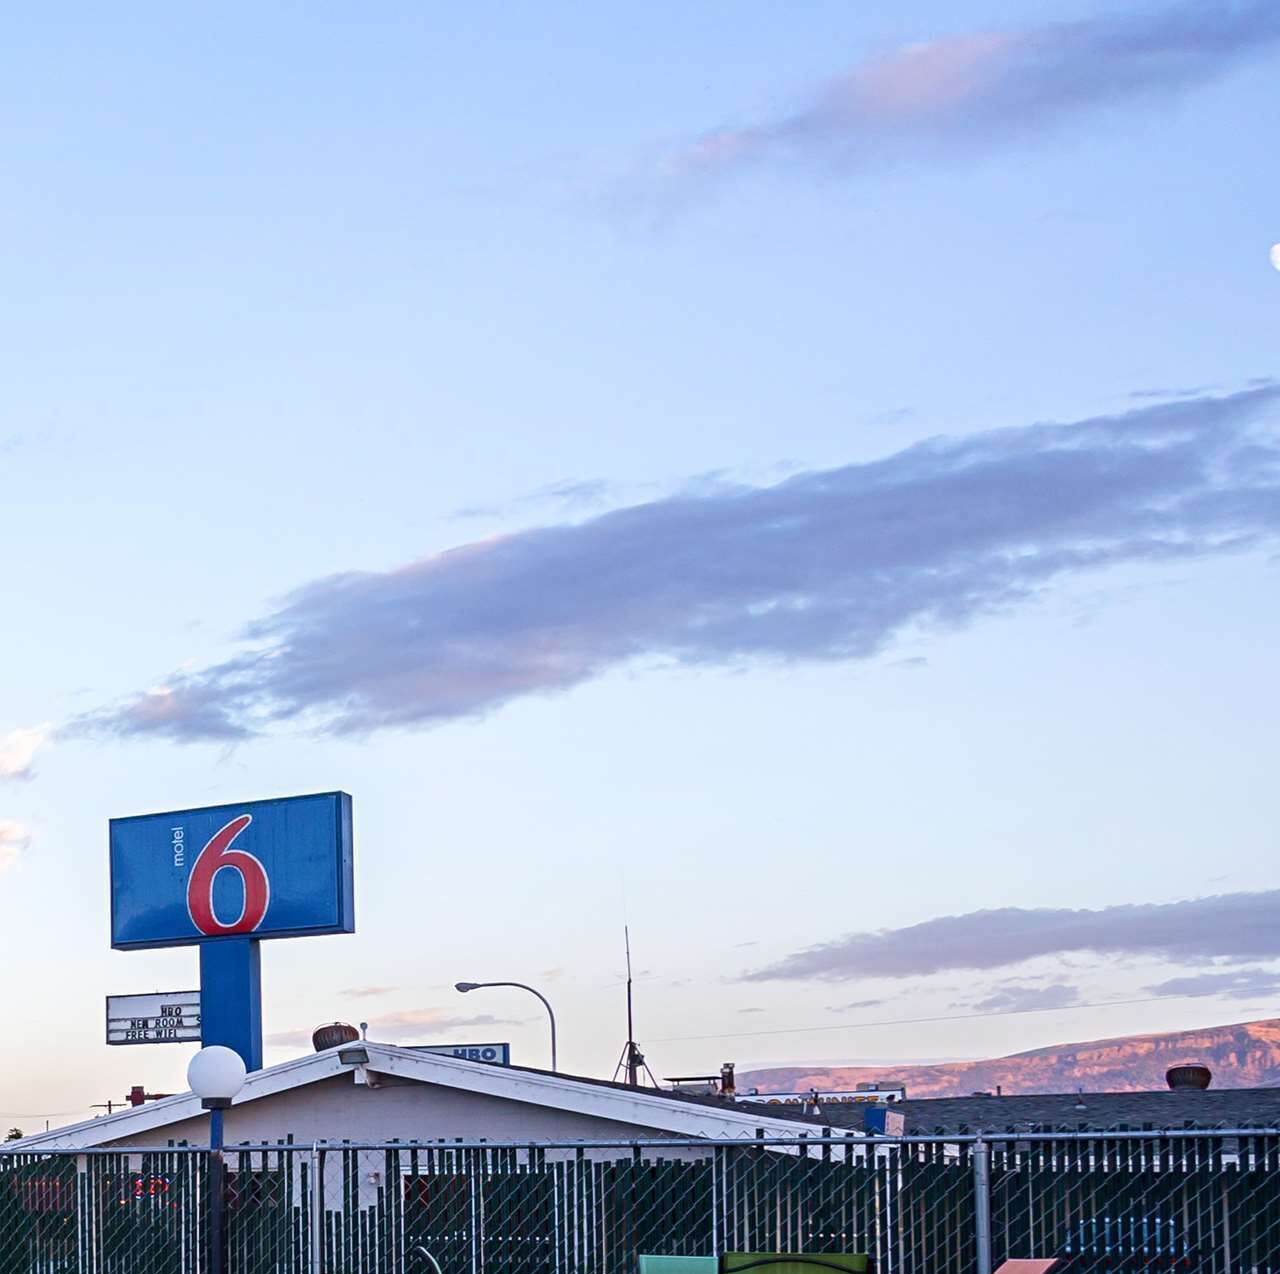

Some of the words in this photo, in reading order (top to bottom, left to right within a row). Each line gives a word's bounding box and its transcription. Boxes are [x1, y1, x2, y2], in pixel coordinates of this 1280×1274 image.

[171, 826, 184, 867] motel
[186, 813, 270, 935] 6
[161, 1007, 181, 1017] HBO
[155, 1017, 184, 1028] ROOM
[126, 1030, 149, 1040] FREE
